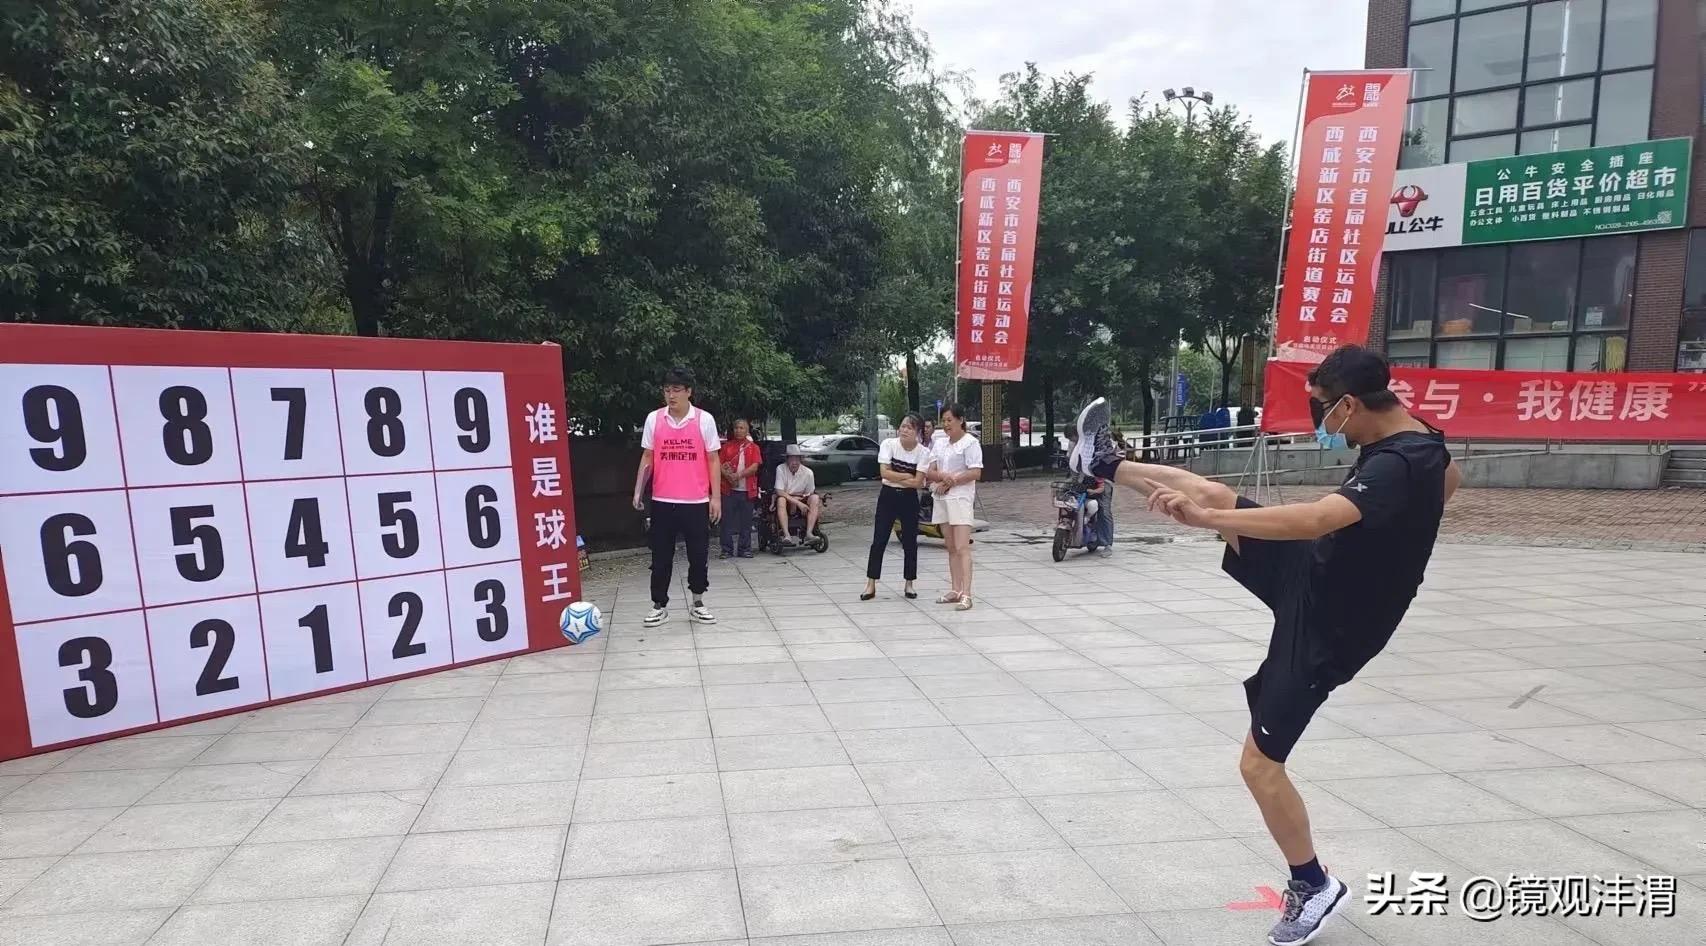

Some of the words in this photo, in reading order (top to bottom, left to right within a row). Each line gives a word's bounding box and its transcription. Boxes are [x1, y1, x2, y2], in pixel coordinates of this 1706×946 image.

[1299, 126, 1344, 321] 西咸新区窑店街道赛区
[1330, 126, 1379, 323] 西安市首届社区运动会
[1475, 166, 1678, 207] 日用百货平价超市
[1496, 151, 1654, 181] 公牛安全插座
[971, 176, 996, 343] 西咸新区窑店街道赛区
[994, 178, 1022, 344] 西安市首届社区运动会
[23, 385, 86, 471] 9
[159, 386, 212, 465] 8
[271, 388, 306, 460] 7
[365, 387, 405, 456] 8
[454, 388, 490, 453] 9
[664, 438, 694, 446] KELME
[40, 513, 102, 596] 6
[170, 505, 224, 582] 5
[285, 498, 328, 568] 4
[378, 491, 419, 558] 5
[465, 485, 500, 548] 6
[525, 402, 572, 603] 谁是球王
[59, 637, 118, 718] 3
[190, 619, 239, 696] 2
[299, 605, 333, 673] 1
[388, 592, 426, 659] 2
[474, 580, 508, 641] 3
